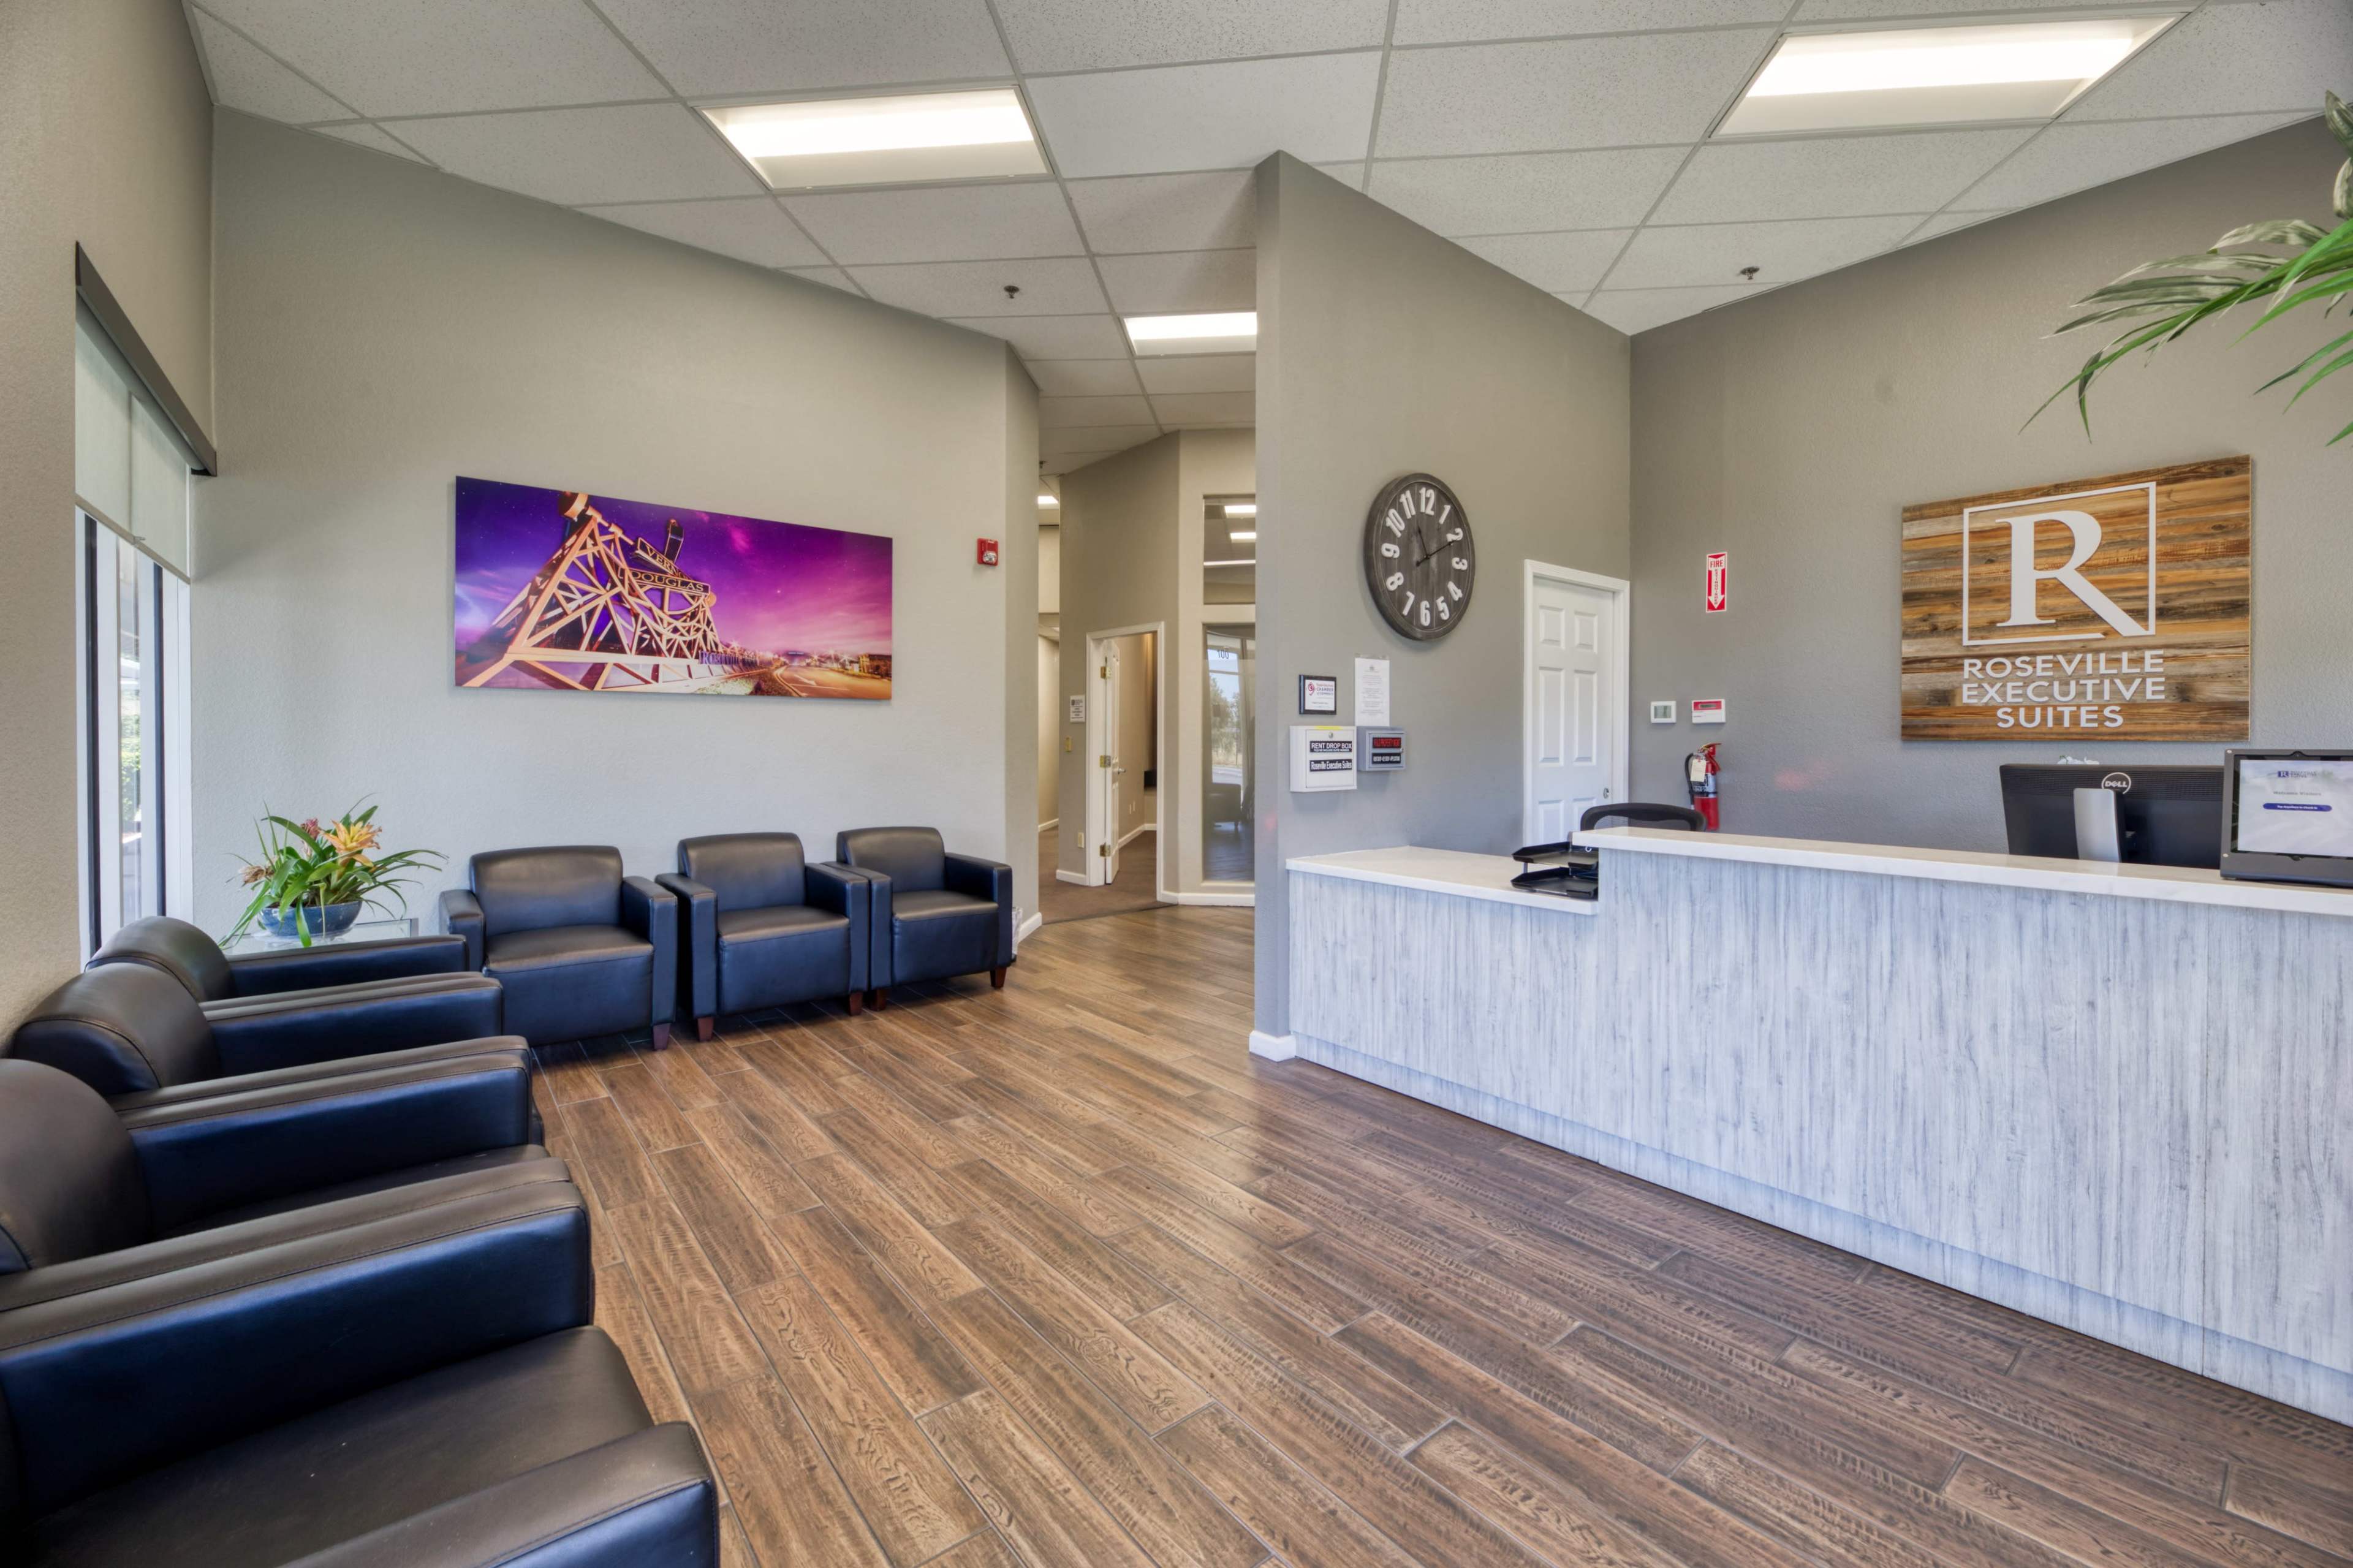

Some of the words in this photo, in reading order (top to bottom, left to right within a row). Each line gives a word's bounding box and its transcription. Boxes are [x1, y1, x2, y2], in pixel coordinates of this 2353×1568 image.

[1400, 490, 1415, 519] 11
[1419, 487, 1434, 515] 12
[1385, 509, 1405, 538] 10
[1439, 504, 1450, 525] 1
[1446, 528, 1463, 544] 2
[1381, 543, 1400, 558] 9
[1452, 557, 1468, 570] 3
[1995, 510, 2148, 637] R
[631, 571, 703, 592] DOUGLAS
[1386, 572, 1404, 591] 8
[1447, 581, 1463, 601] 4
[1403, 591, 1415, 616] 7
[1420, 600, 1431, 626] 6
[1436, 596, 1450, 620] 5
[1963, 650, 2164, 679] ROSEVILLE
[1962, 677, 2165, 704] EXECUTIVE
[1996, 705, 2124, 729] SUITES
